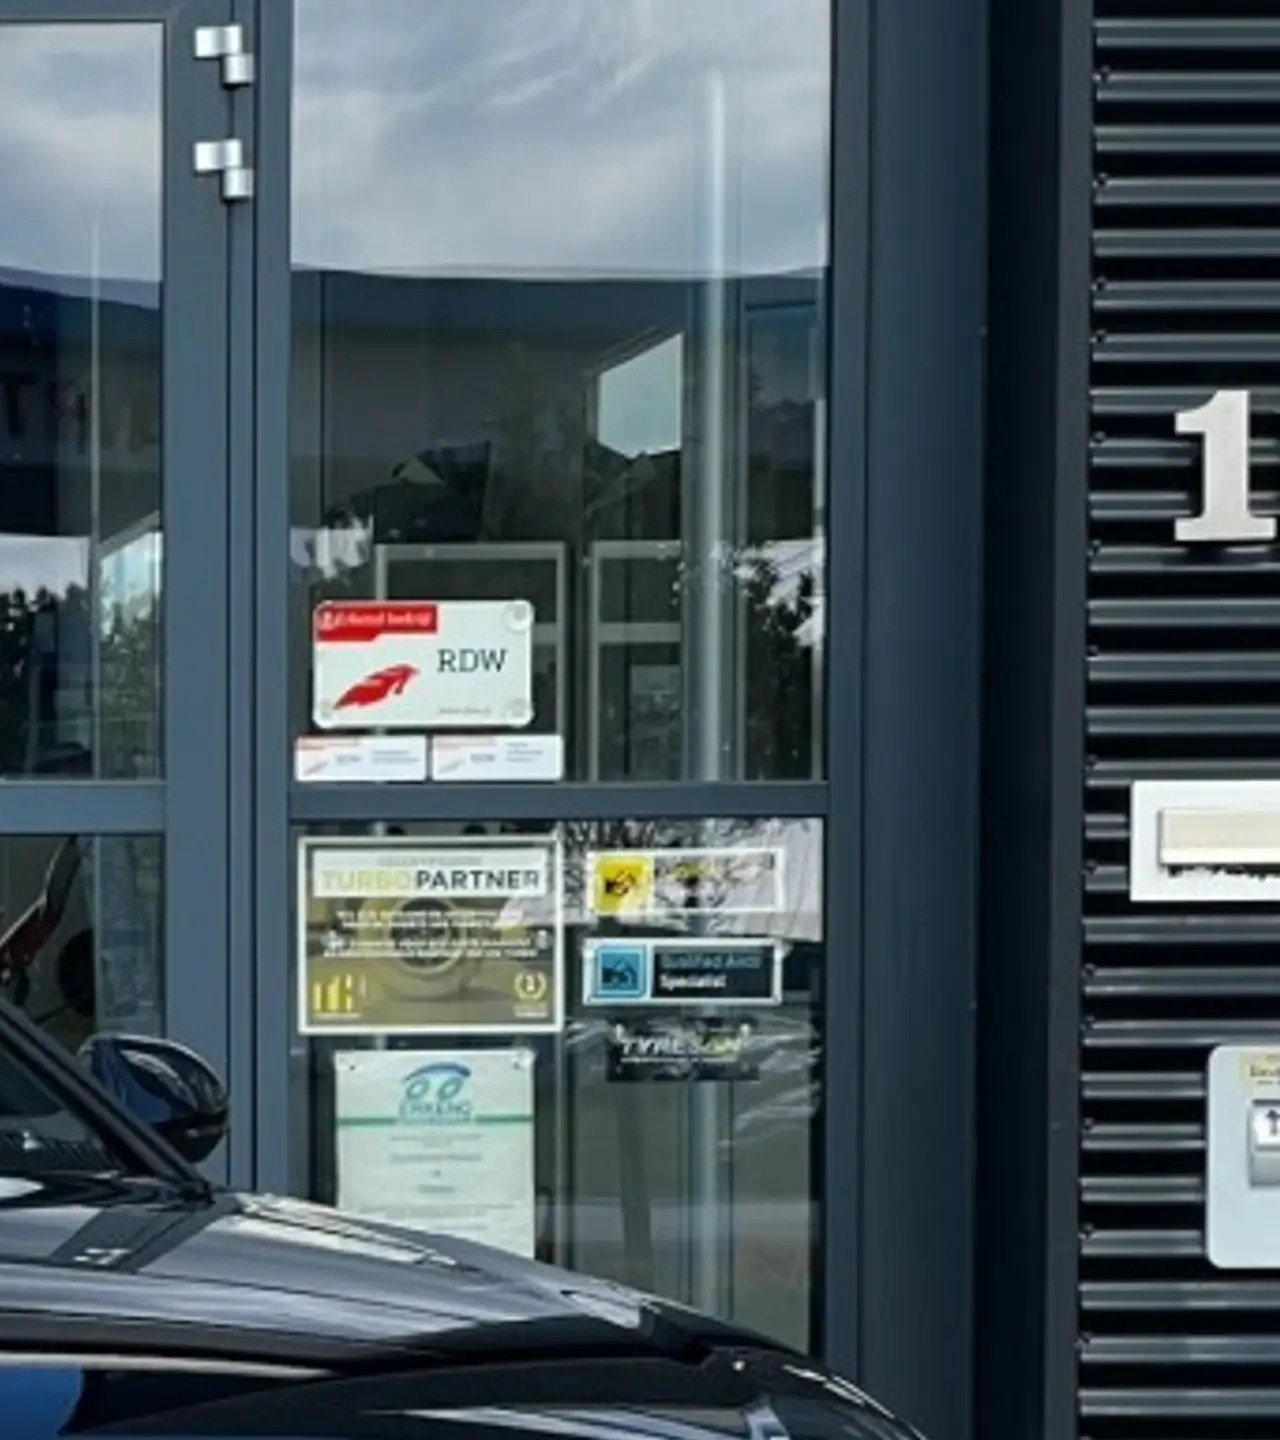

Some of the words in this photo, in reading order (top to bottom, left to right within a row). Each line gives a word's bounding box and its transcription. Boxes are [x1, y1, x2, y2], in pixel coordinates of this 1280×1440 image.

[1175, 389, 1276, 541] 1
[436, 648, 507, 673] RDW
[322, 868, 540, 892] TURBOPARTNER
